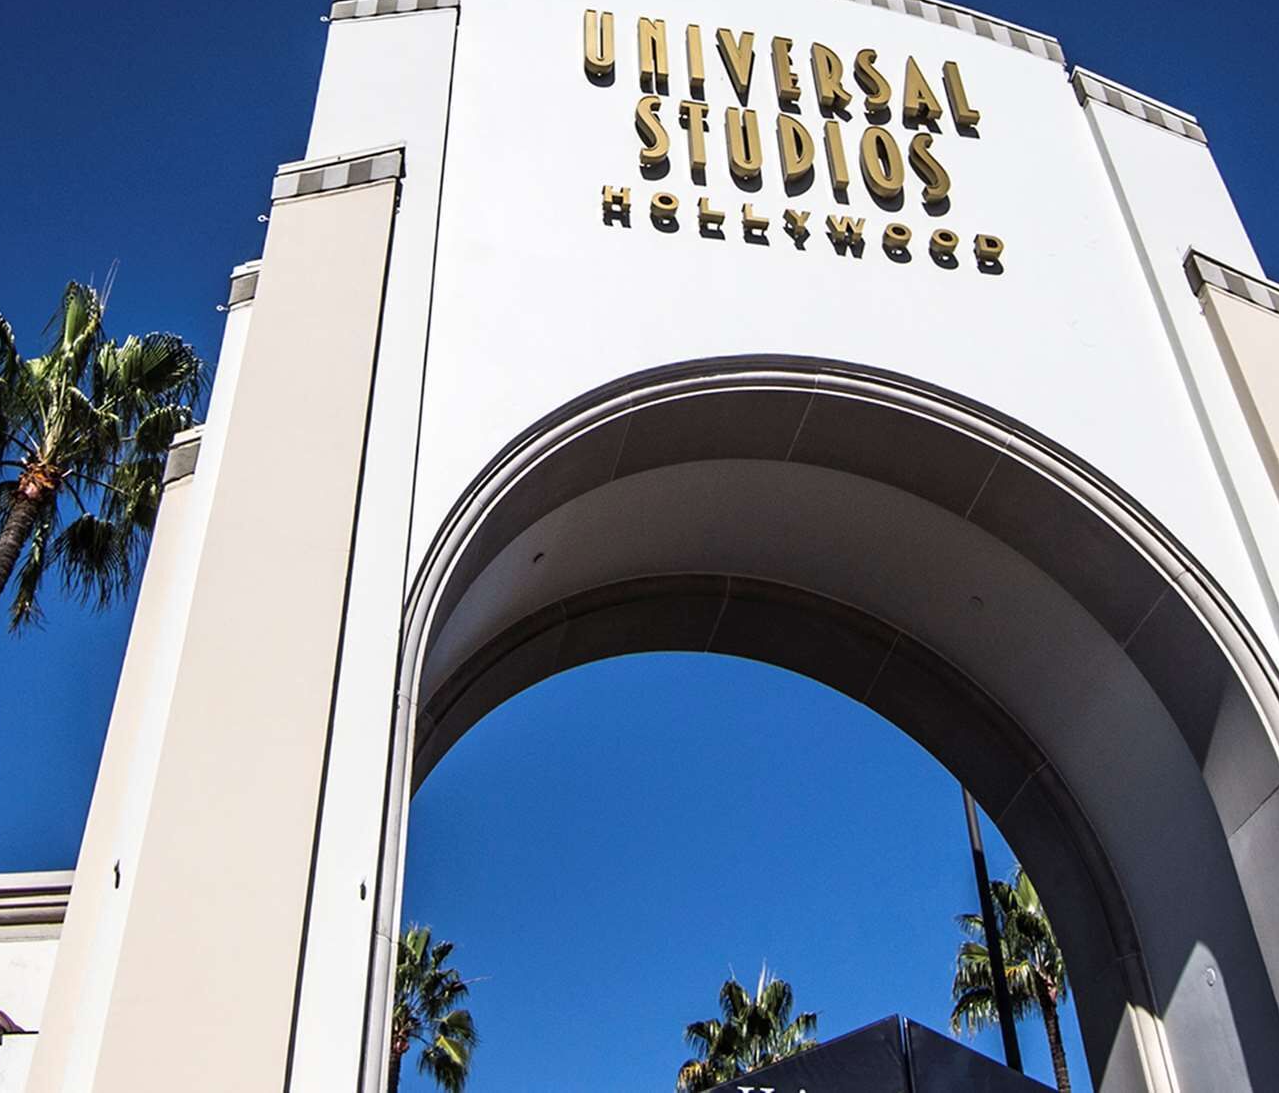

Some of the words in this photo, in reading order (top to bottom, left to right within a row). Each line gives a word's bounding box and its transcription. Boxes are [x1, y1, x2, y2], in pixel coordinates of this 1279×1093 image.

[583, 8, 980, 128] UNIVERSAL
[634, 95, 951, 205] STUDIOS
[601, 184, 1005, 265] HOLLYWOOD
